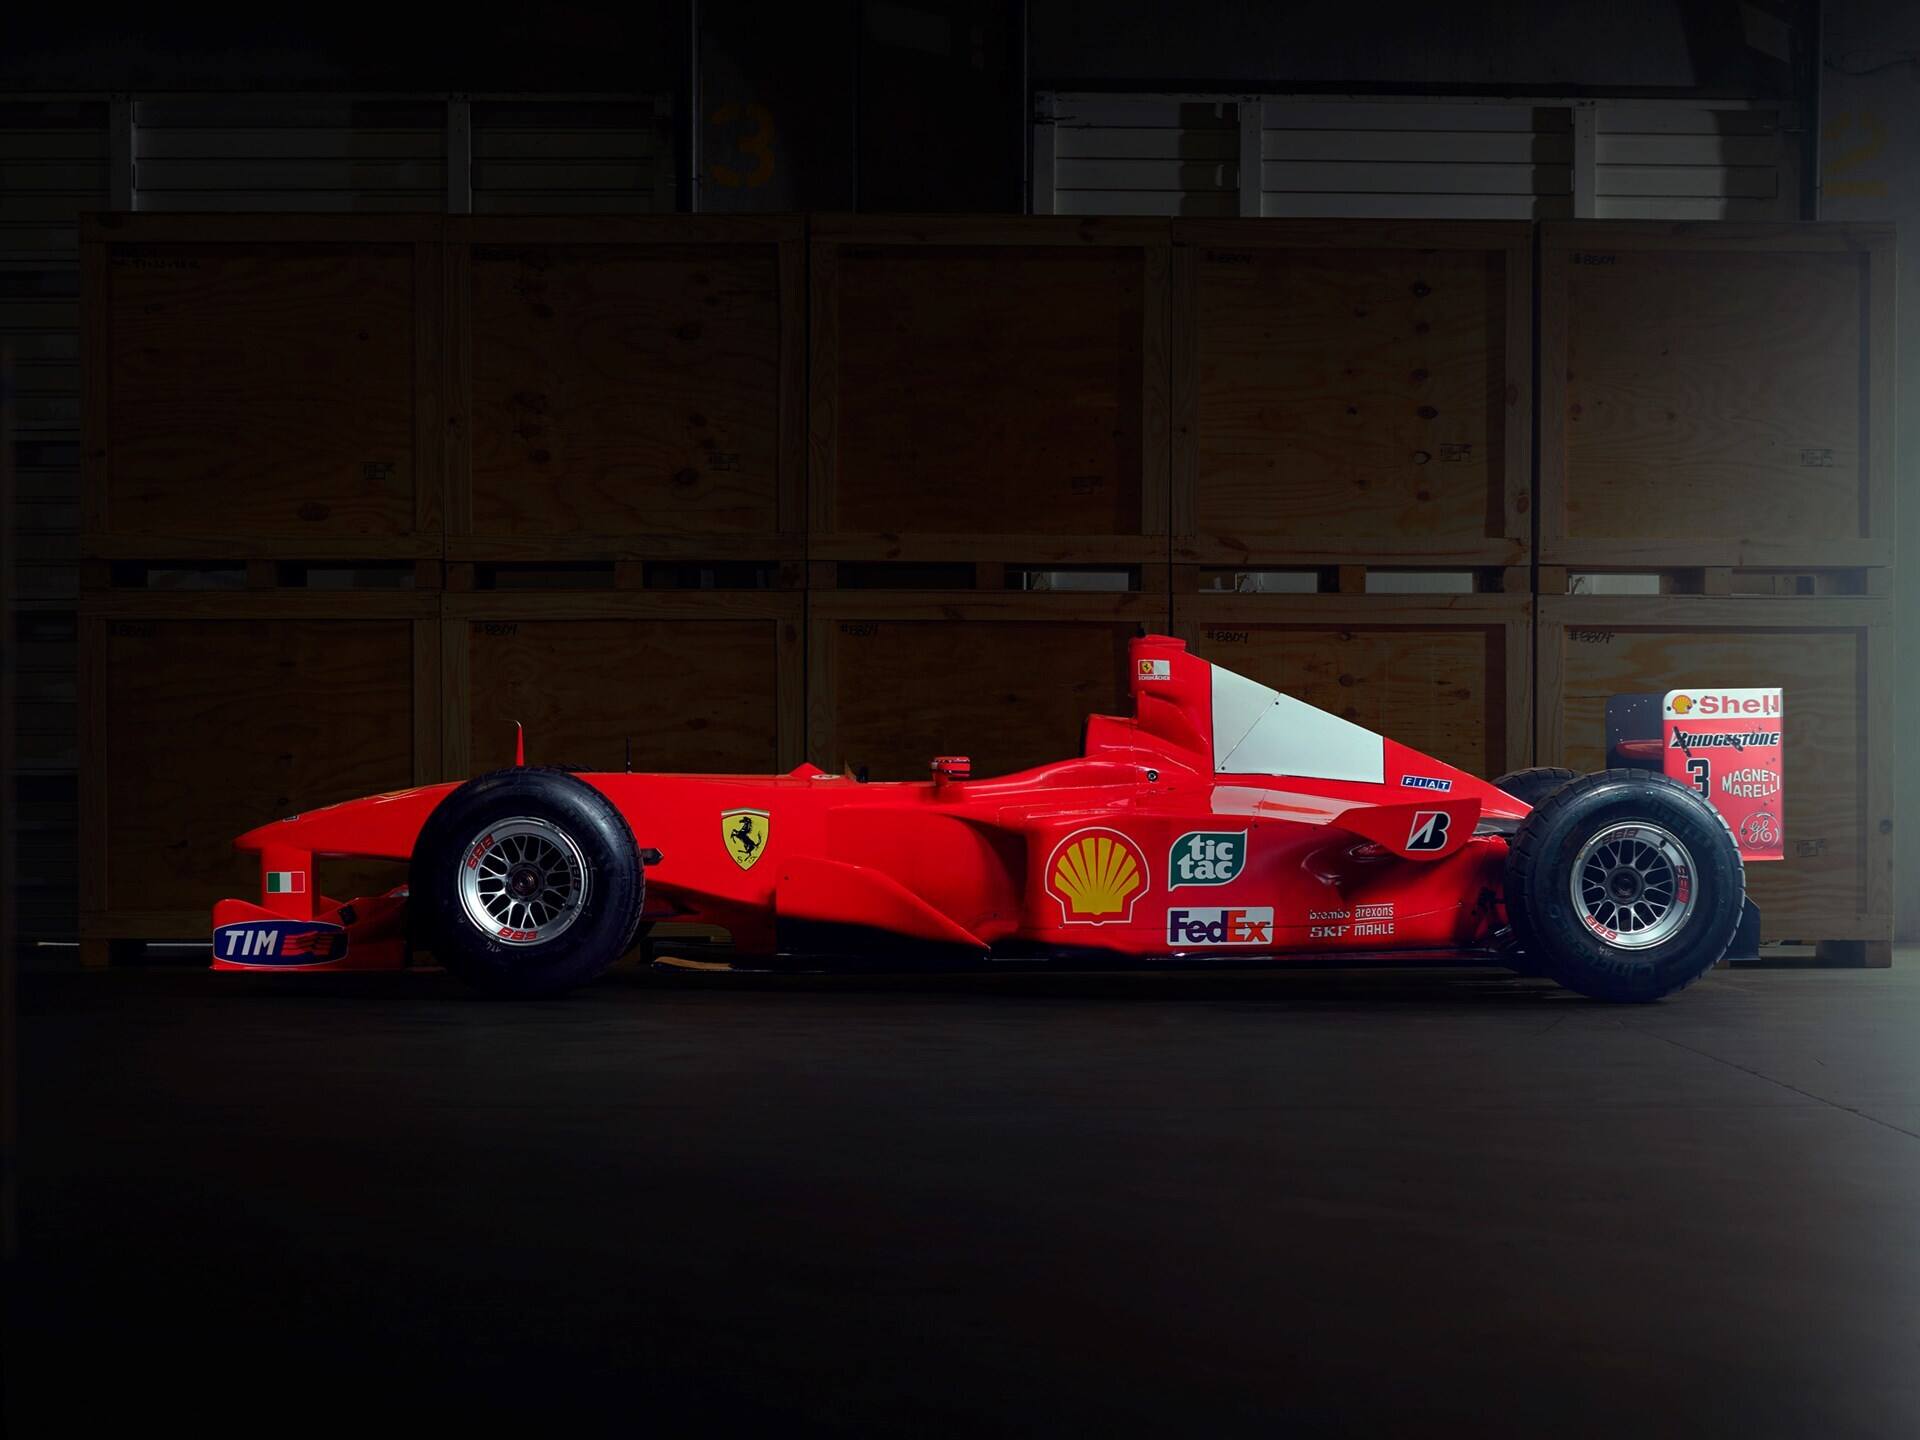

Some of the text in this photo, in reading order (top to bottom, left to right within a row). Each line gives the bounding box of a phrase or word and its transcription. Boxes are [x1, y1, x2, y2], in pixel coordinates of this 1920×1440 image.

[710, 101, 774, 189] 3
[1823, 110, 1888, 198] 2
[1699, 695, 1779, 714] Shell
[1404, 777, 1449, 790] FIAT
[1687, 758, 1710, 800] 3
[1722, 769, 1780, 787] MAGNETI
[1722, 780, 1780, 798] MARELLI
[1187, 834, 1234, 861] tic
[1177, 854, 1232, 880] tac
[1355, 906, 1394, 919] arexons
[1170, 910, 1270, 943] FedEx
[1309, 925, 1351, 938] SKF
[1354, 922, 1394, 937] MAHLE
[1585, 914, 1617, 940] BBS
[225, 930, 279, 956] TIM
